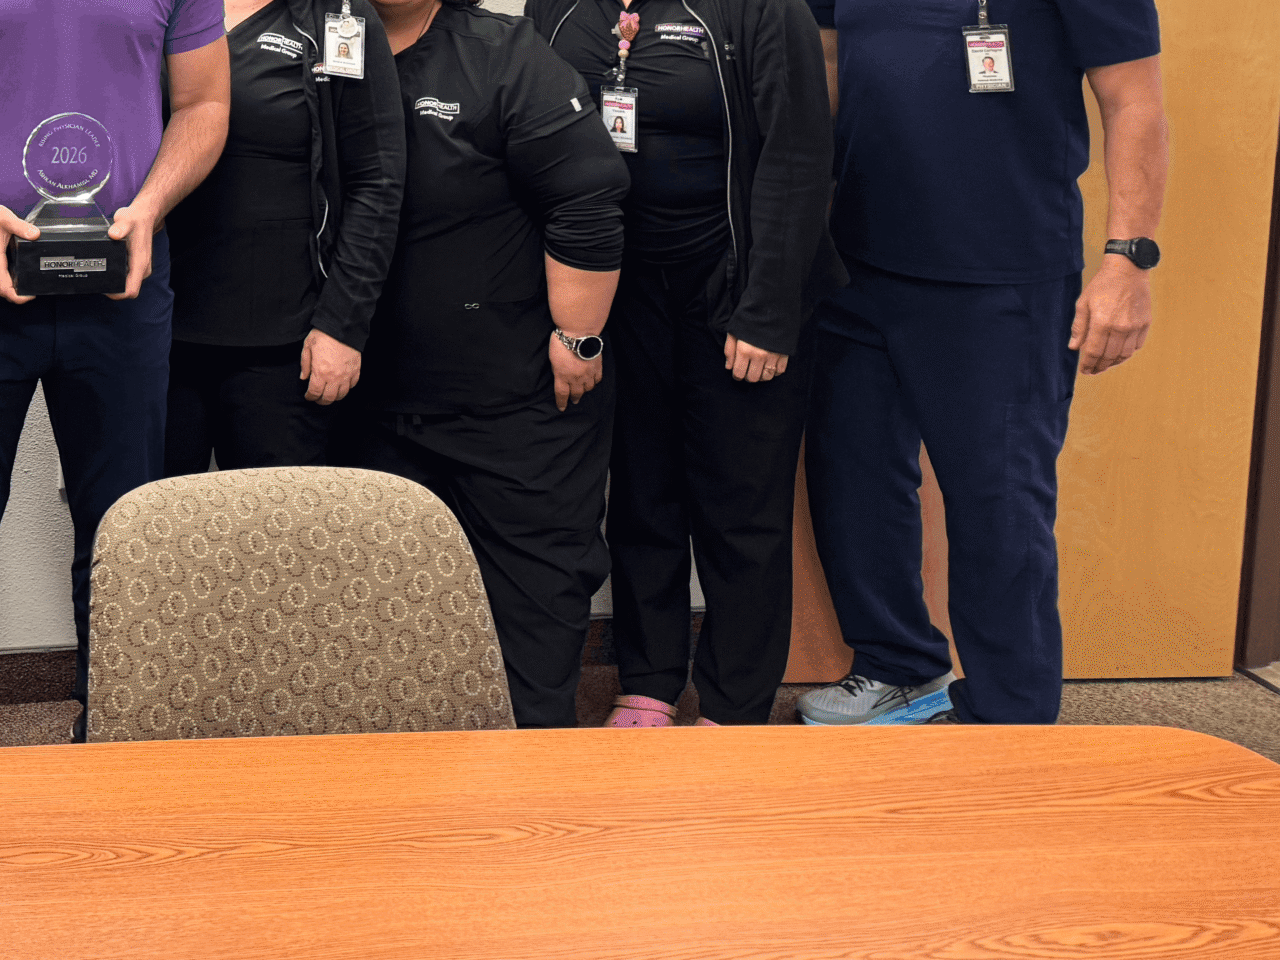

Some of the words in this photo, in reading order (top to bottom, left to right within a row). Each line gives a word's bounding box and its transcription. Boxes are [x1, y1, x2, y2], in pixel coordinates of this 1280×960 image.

[661, 33, 682, 41] Medical
[681, 35, 699, 43] Group
[51, 146, 87, 164] 2026
